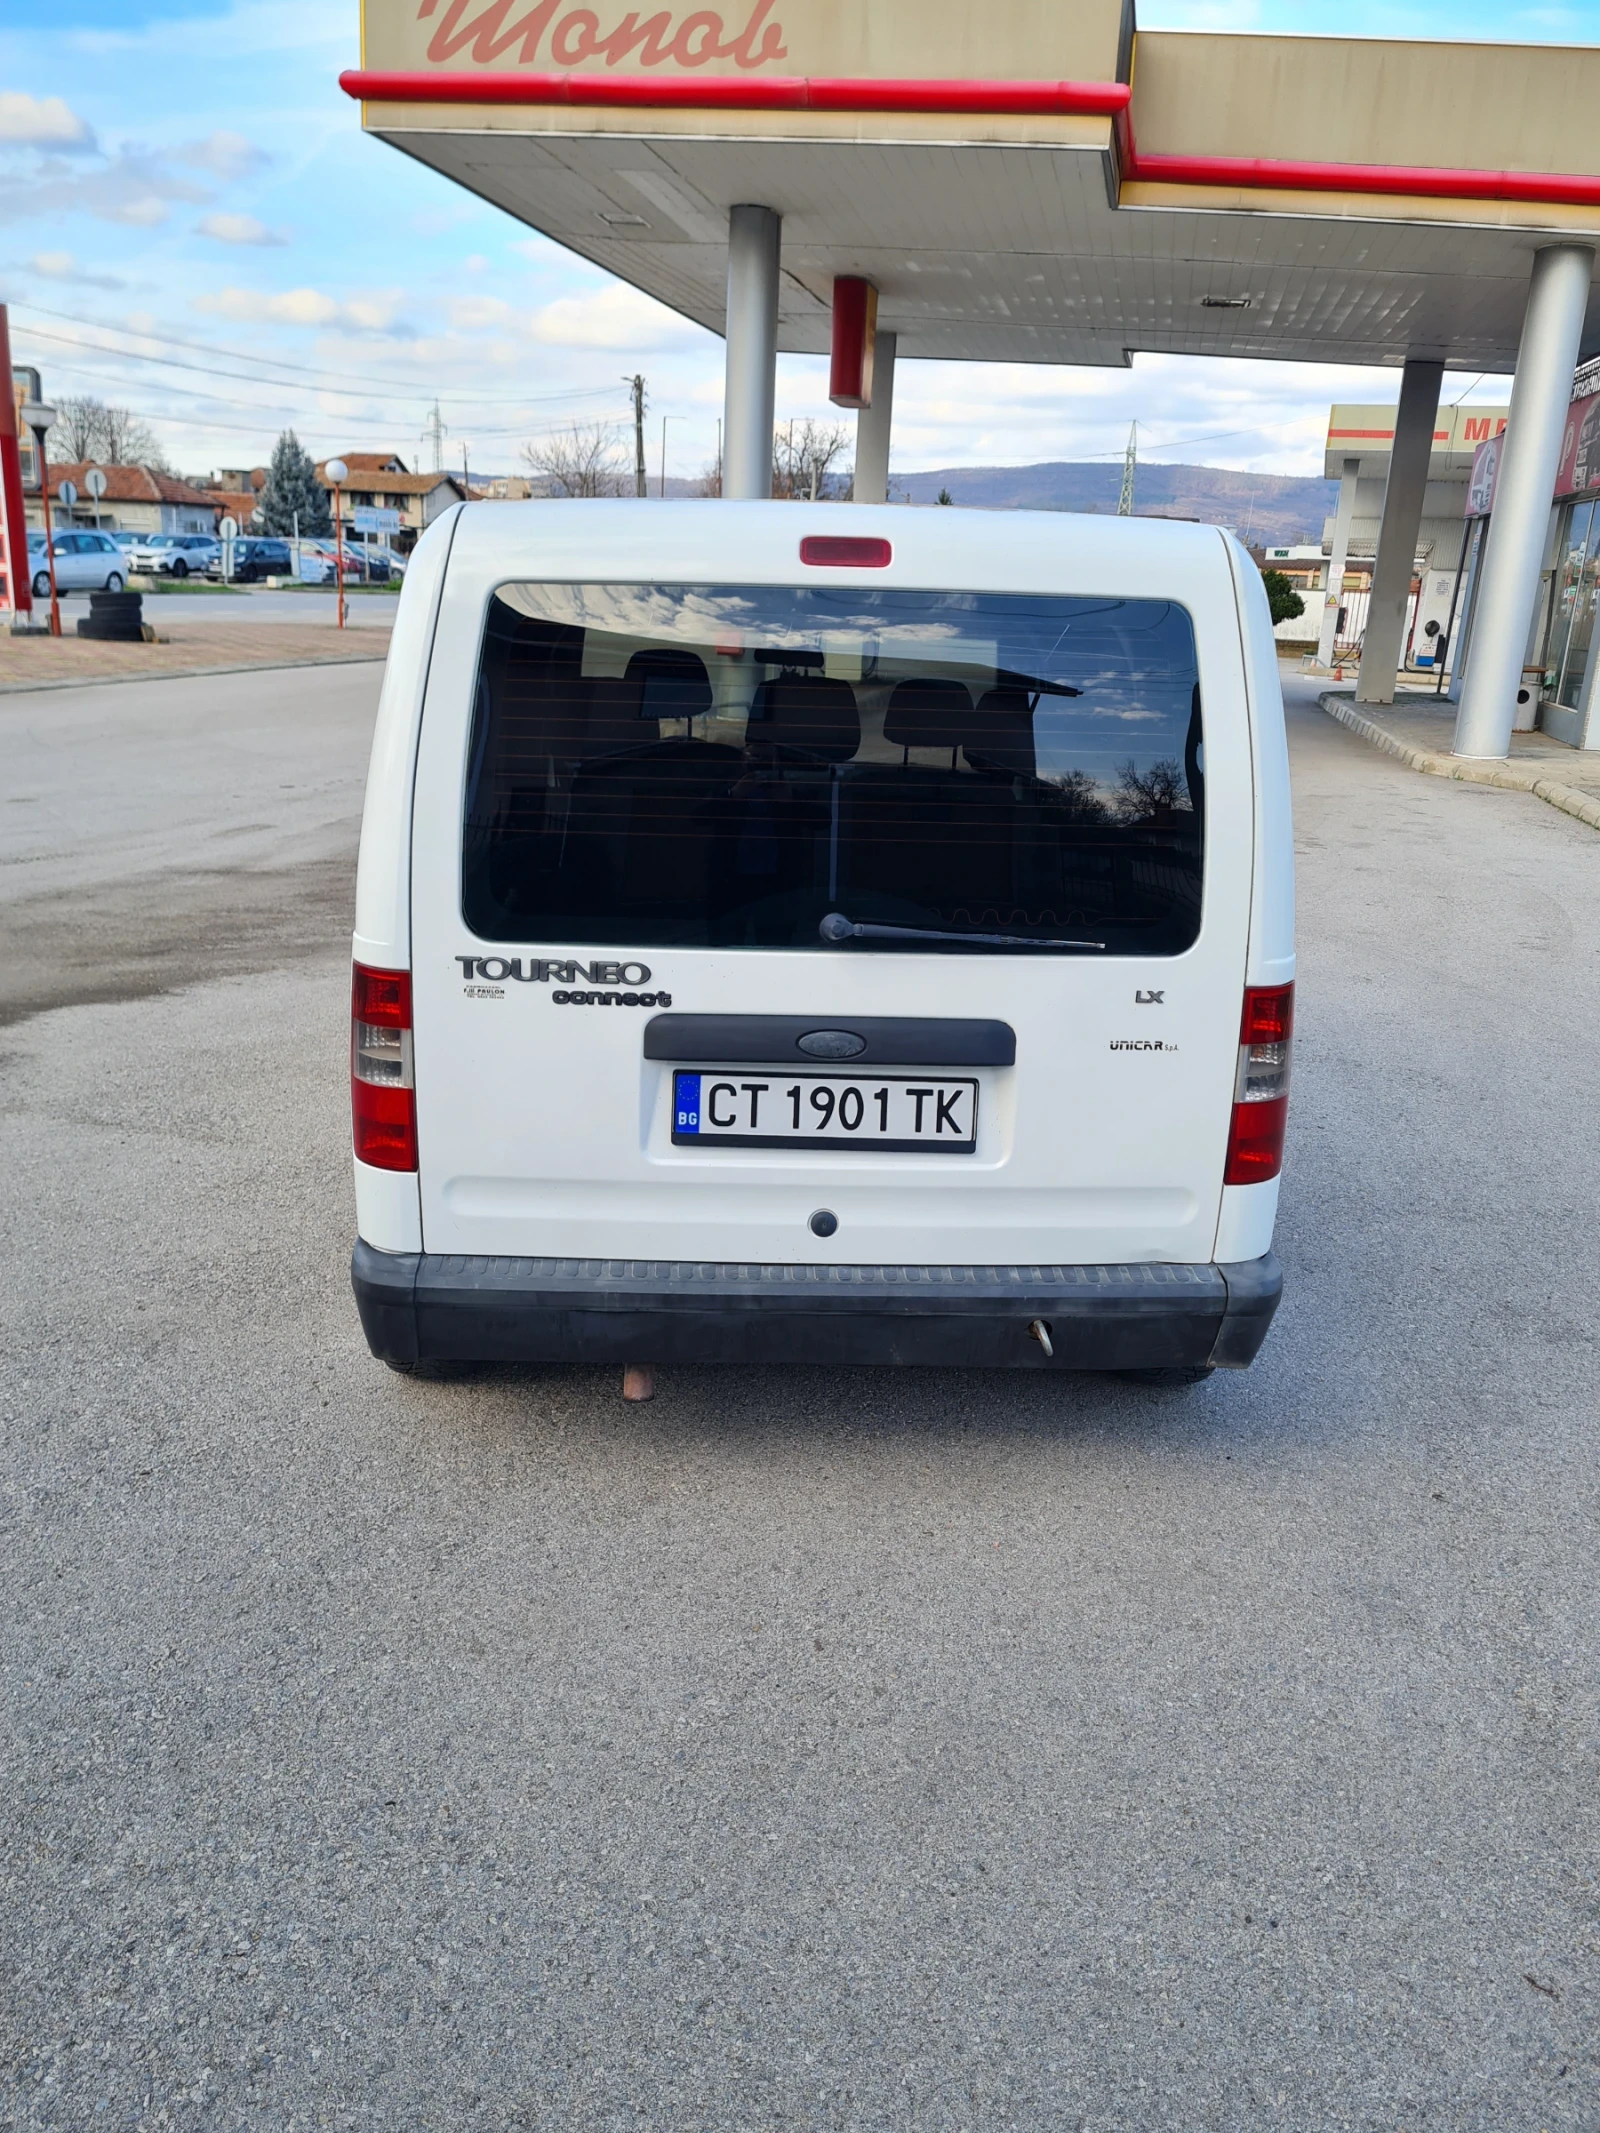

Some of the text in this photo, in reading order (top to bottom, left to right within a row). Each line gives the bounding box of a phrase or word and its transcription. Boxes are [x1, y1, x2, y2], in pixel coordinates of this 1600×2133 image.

[455, 956, 652, 985] TOURNEO
[552, 990, 672, 1008] connect
[1135, 990, 1165, 1004] LX
[1110, 1040, 1164, 1051] UNICAR
[708, 1083, 964, 1134] CT 1901 TK
[678, 1111, 698, 1125] BG
